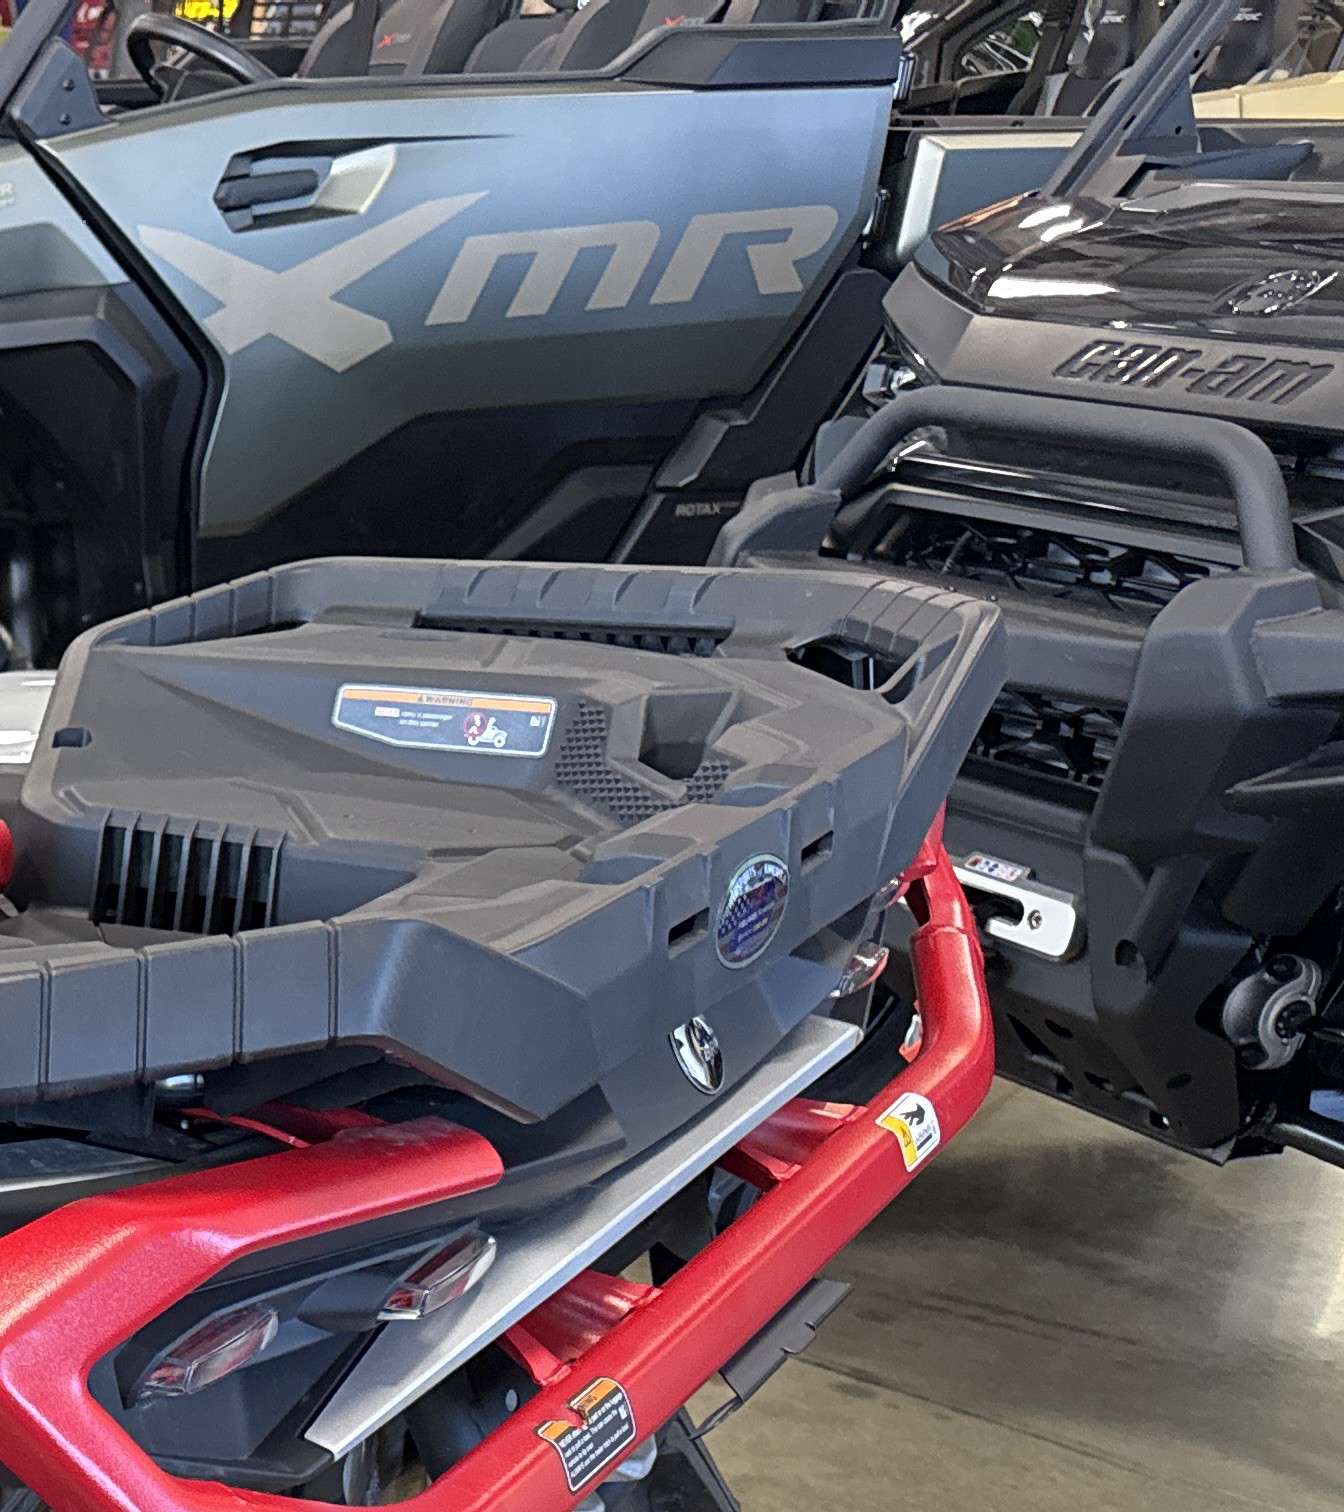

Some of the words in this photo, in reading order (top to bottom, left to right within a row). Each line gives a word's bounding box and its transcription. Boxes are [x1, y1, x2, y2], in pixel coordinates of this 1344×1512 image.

[1051, 340, 1335, 405] can-am
[675, 501, 721, 517] ROTAX
[425, 696, 474, 706] WARNING
